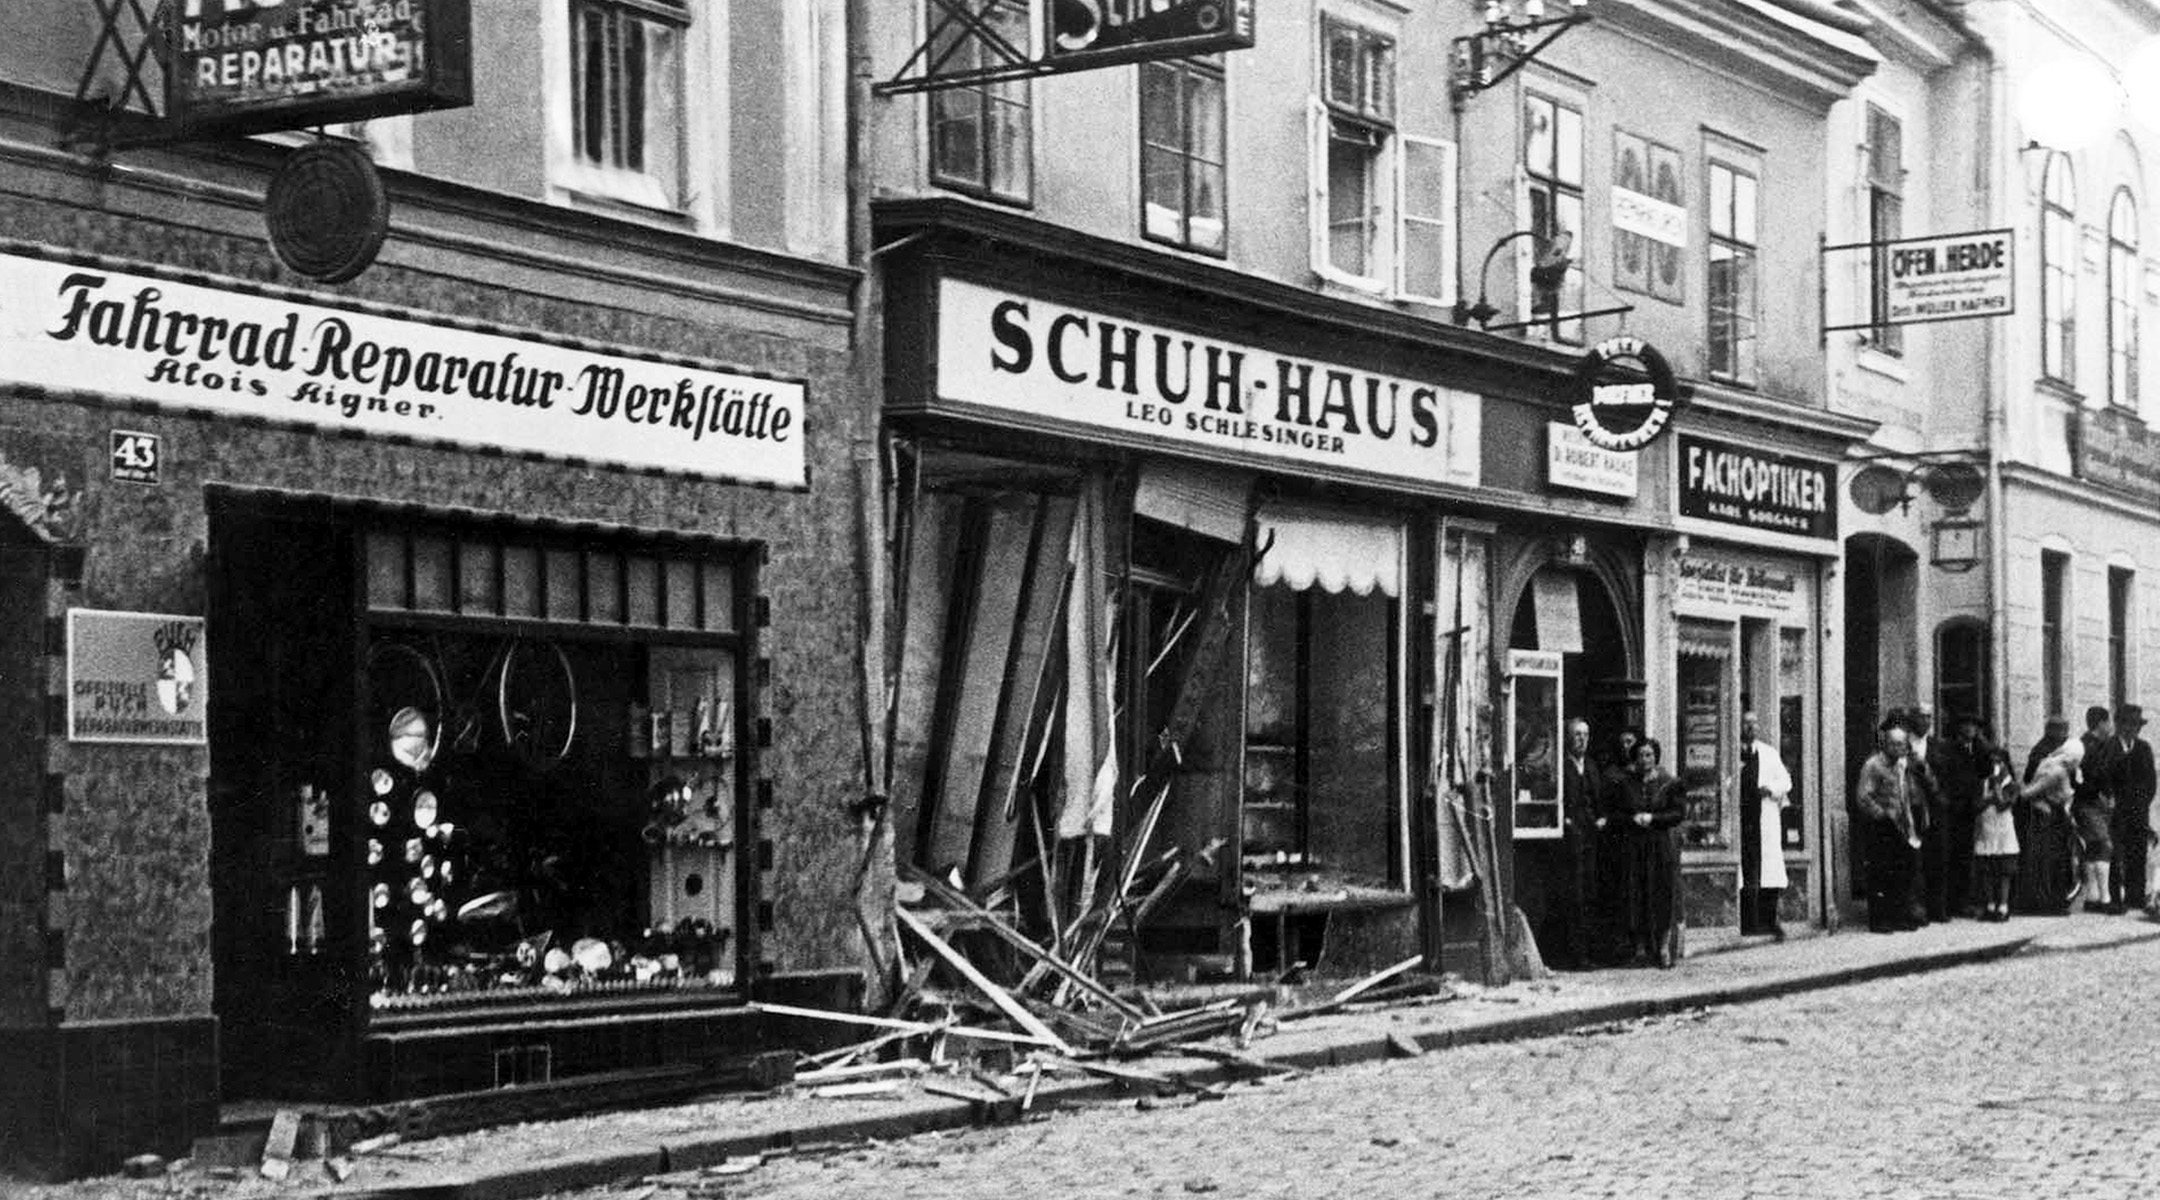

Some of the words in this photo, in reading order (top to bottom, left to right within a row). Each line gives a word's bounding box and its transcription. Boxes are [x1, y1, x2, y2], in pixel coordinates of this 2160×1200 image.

[198, 32, 398, 86] REPARATUR
[991, 299, 1439, 448] SCHUH-HAUS
[114, 437, 155, 468] 43
[1126, 400, 1172, 427] LEO
[1185, 412, 1345, 454] SCHLESINGER
[1688, 446, 1827, 513] FACHOPTIKER
[95, 695, 147, 713] PUCH
